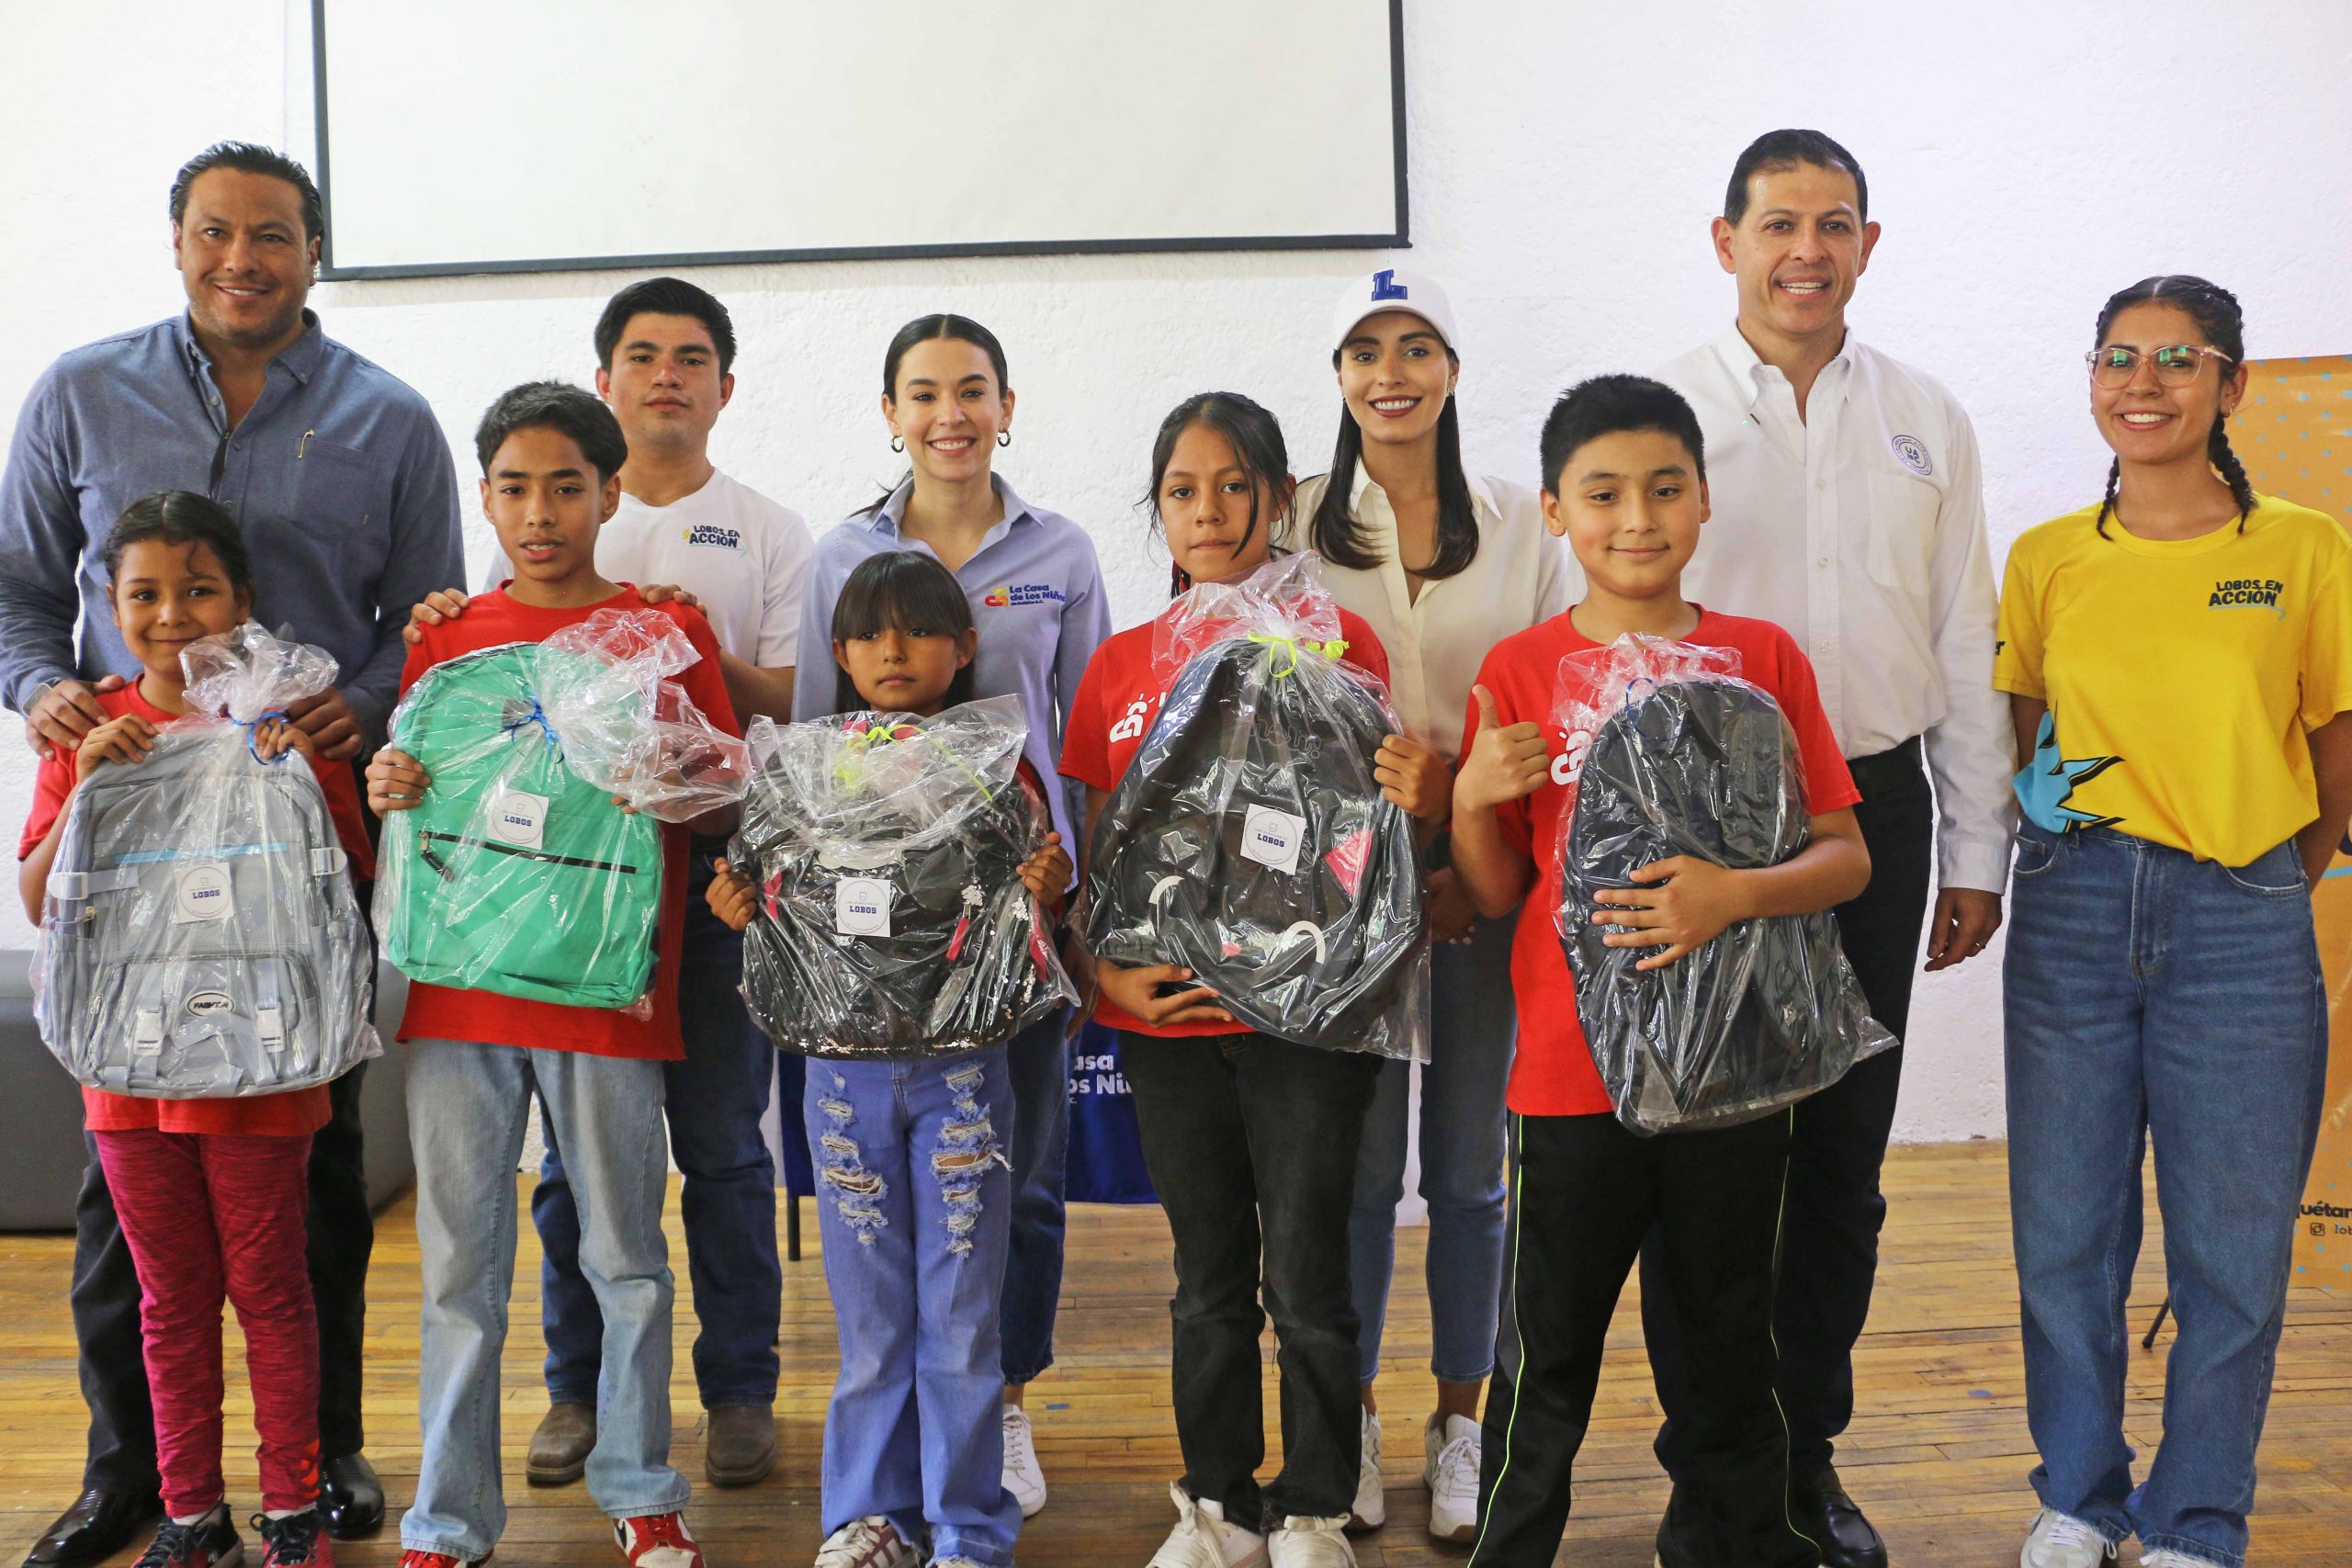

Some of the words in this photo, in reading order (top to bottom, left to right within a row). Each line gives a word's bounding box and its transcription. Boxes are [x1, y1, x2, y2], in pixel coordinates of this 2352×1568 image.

[1371, 269, 1408, 301] L
[693, 525, 724, 536] LOBOS
[689, 533, 738, 548] ACCIÓN
[1023, 584, 1049, 592] Casa
[2216, 579, 2261, 592] LOBOS
[2265, 580, 2284, 593] EN
[503, 815, 532, 827] LOBOS
[1257, 832, 1285, 848] LOBOS
[192, 889, 220, 899] LOBOS
[849, 905, 876, 914] LOBOS
[2296, 1200, 2352, 1220] uétar
